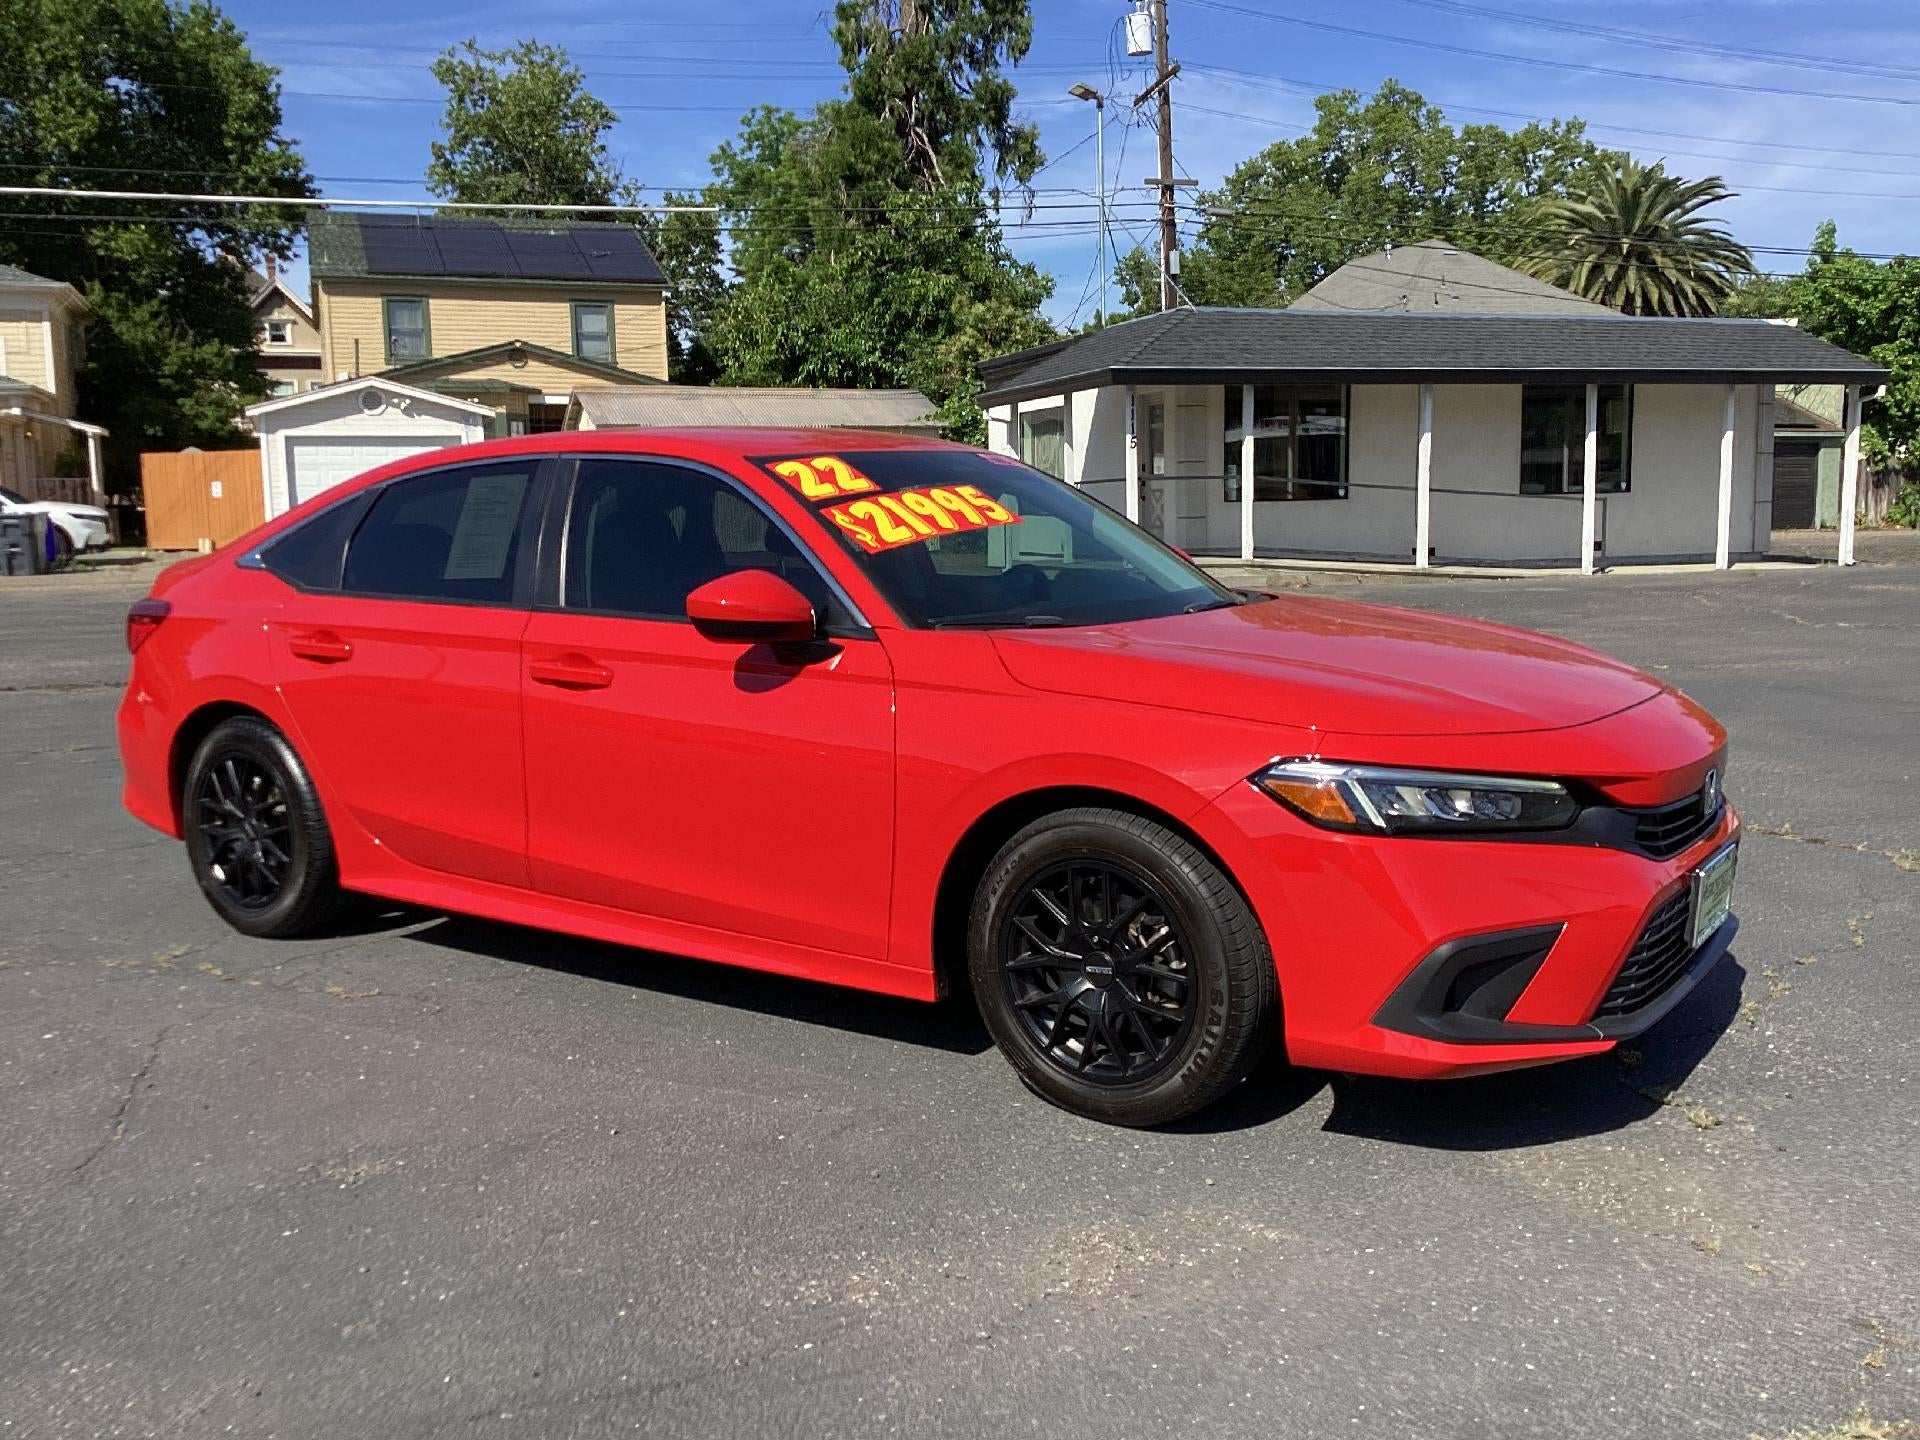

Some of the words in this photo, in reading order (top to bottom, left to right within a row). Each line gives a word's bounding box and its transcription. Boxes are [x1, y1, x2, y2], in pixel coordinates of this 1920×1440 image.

[1130, 393, 1138, 449] 1115
[774, 456, 875, 498] 22
[830, 485, 1015, 549] $21995
[1179, 987, 1225, 1086] SAILUN
